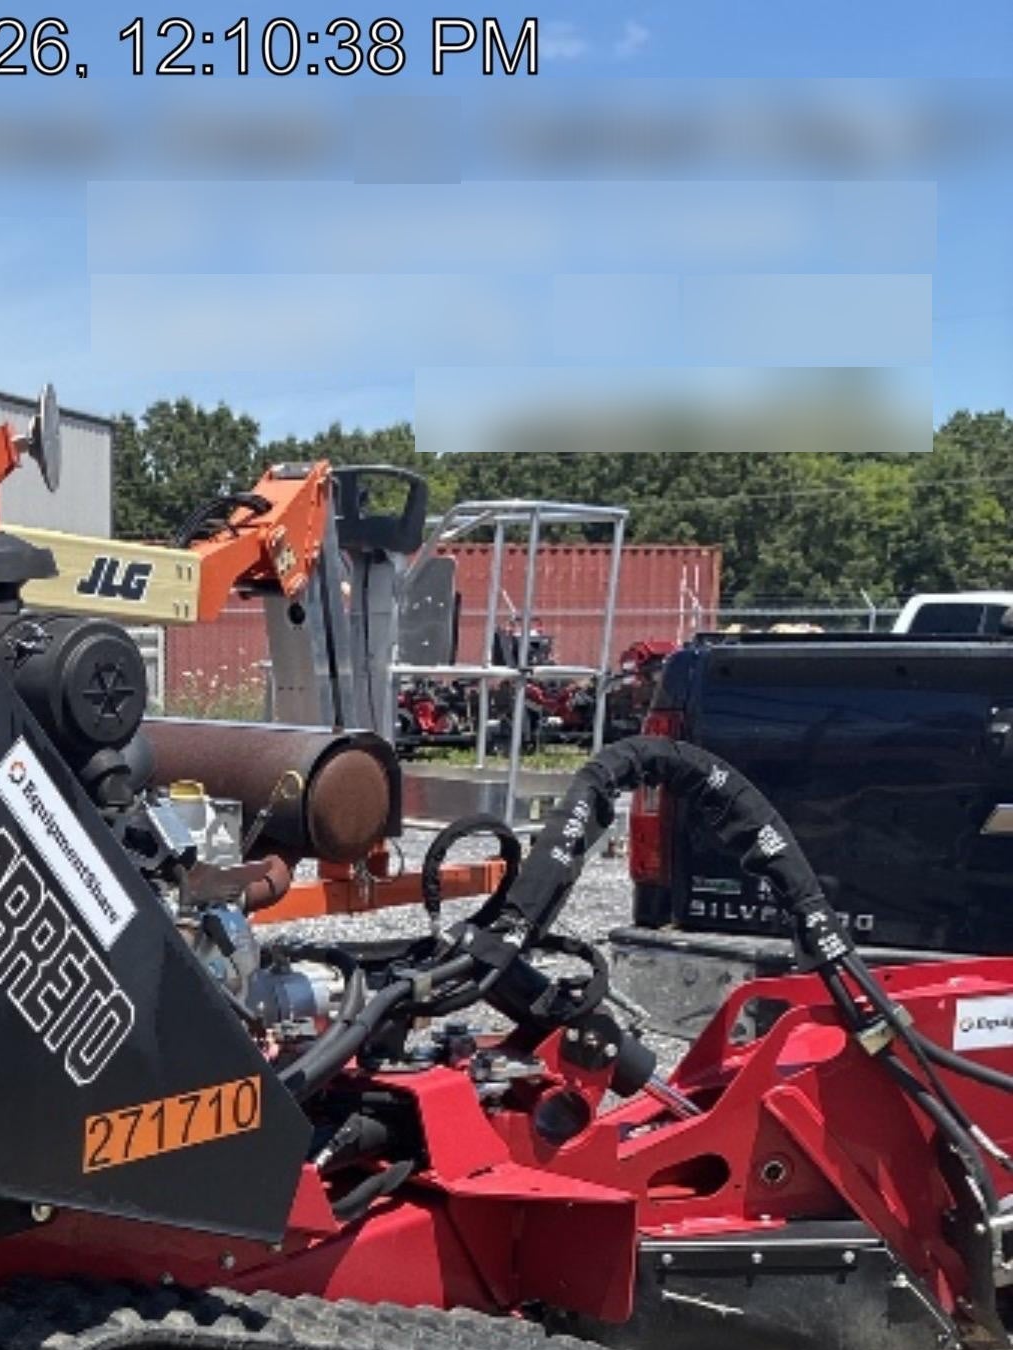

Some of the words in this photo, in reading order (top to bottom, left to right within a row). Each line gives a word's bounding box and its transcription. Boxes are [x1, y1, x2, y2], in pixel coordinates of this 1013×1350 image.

[75, 555, 154, 602] JLG
[22, 780, 122, 924] EquipmentShare
[88, 1079, 259, 1168] 271710
